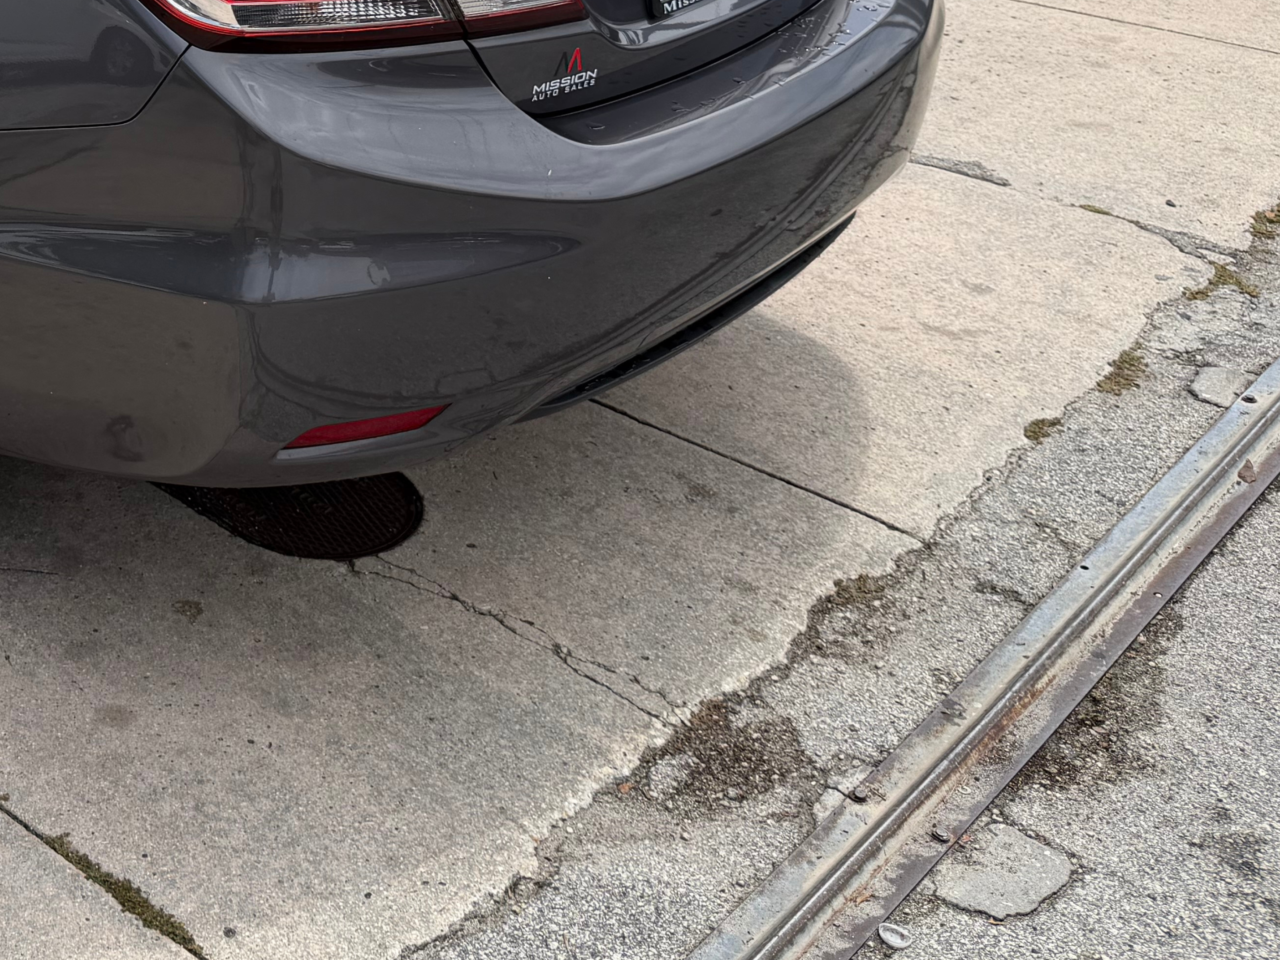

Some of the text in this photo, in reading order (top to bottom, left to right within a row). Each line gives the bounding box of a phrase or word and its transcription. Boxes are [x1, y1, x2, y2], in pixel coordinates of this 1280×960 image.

[531, 78, 596, 102] AUTO SALES
[532, 68, 598, 95] MISSION
